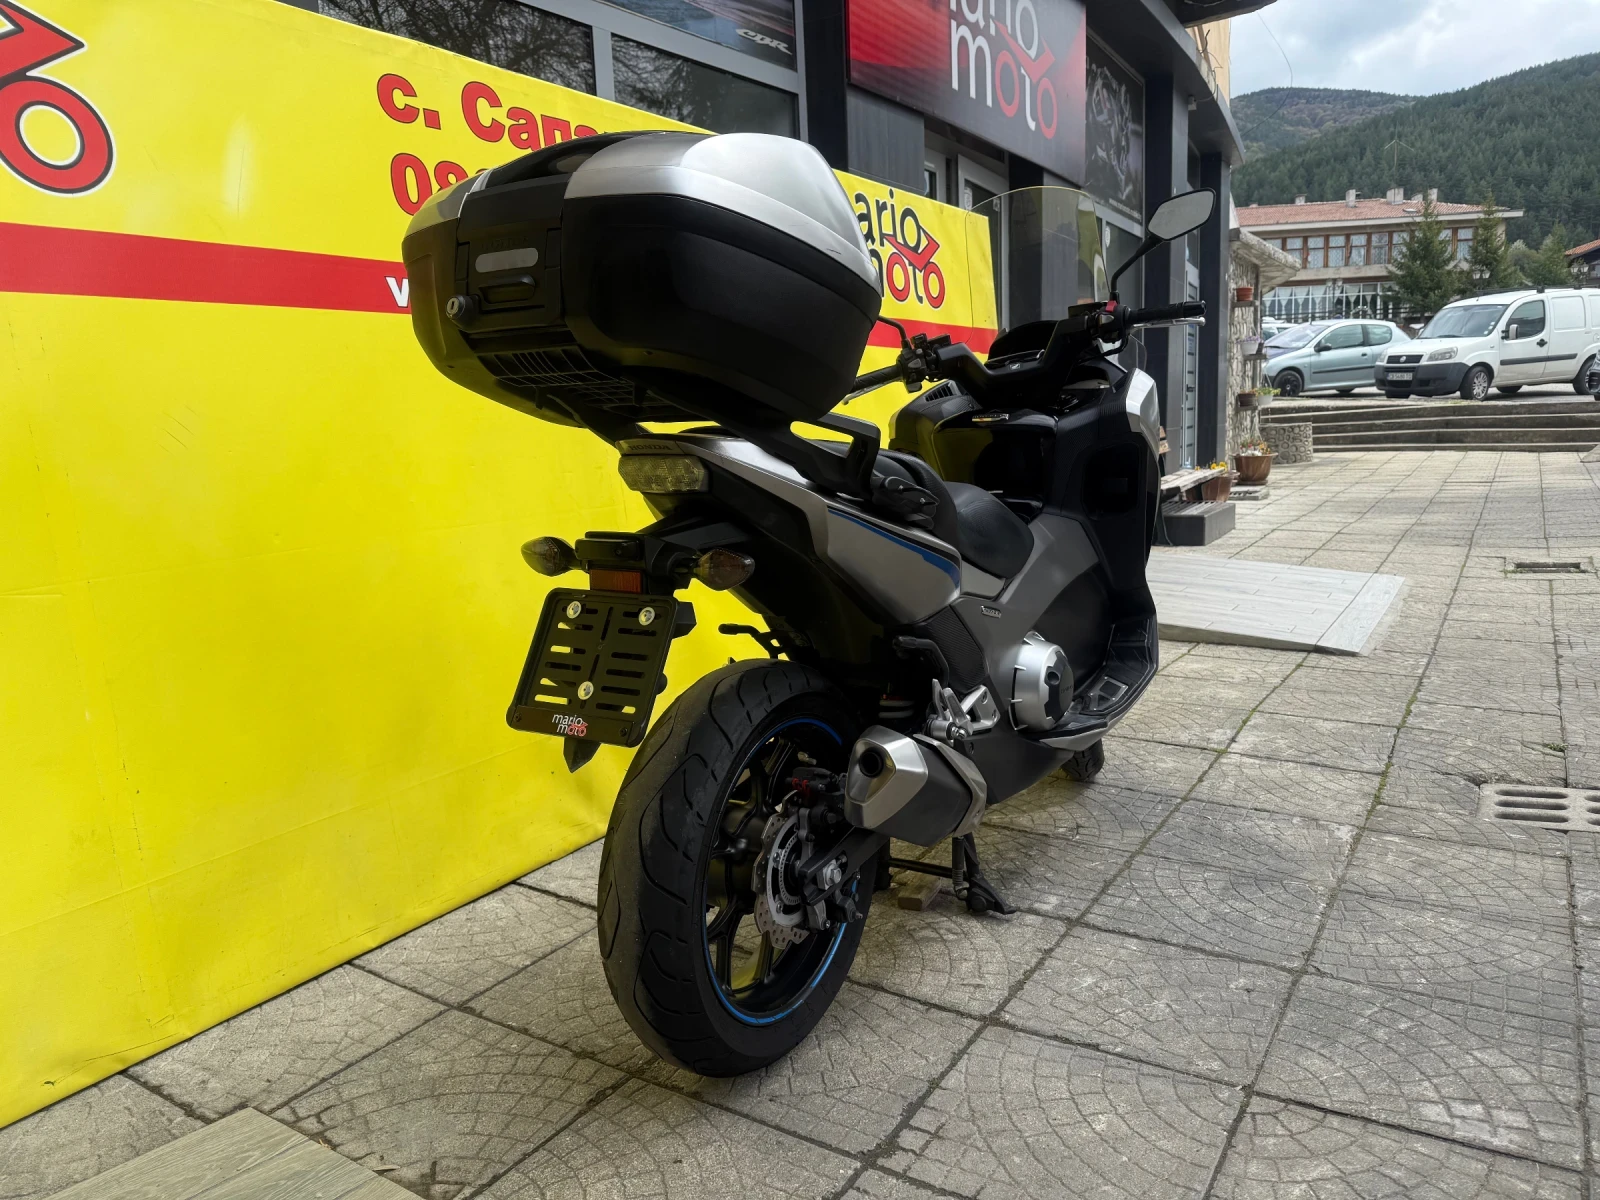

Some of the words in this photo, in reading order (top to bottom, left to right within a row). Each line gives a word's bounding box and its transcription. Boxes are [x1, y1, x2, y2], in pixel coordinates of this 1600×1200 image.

[735, 28, 793, 56] CBR
[950, 18, 1058, 139] moto
[461, 81, 600, 152] Сап
[854, 188, 921, 254] ario
[552, 714, 583, 726] mario
[556, 723, 587, 737] moto
